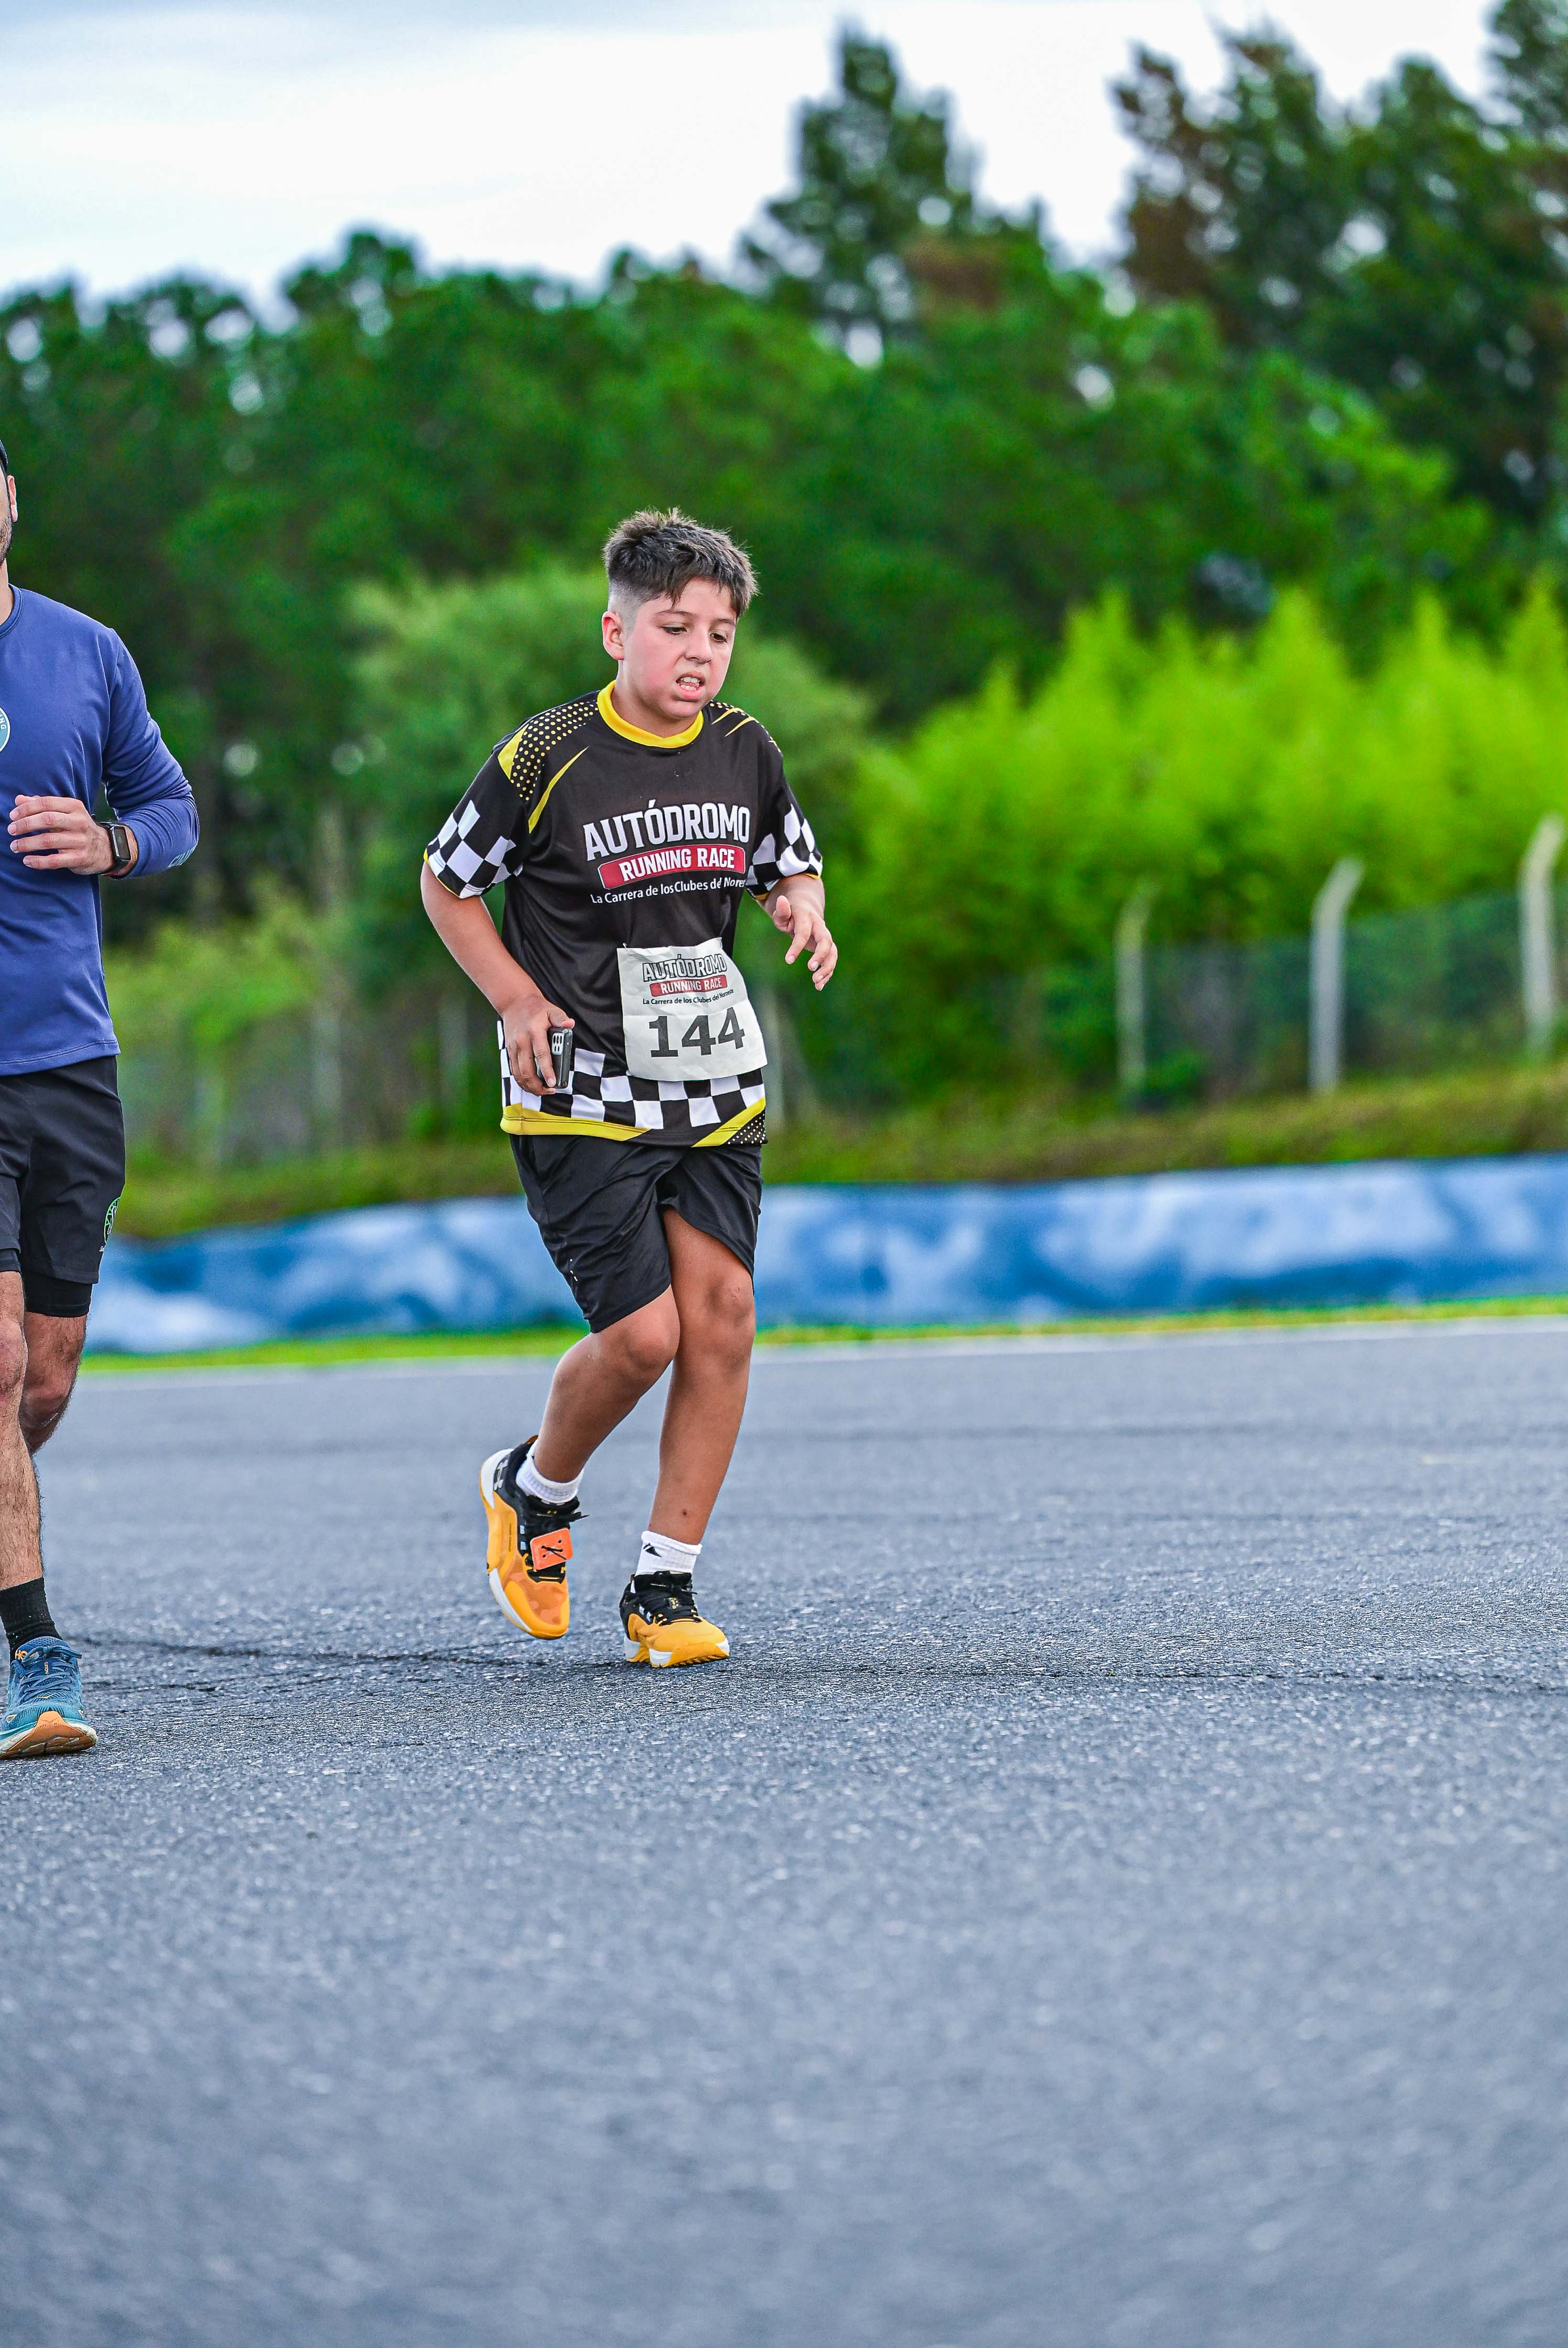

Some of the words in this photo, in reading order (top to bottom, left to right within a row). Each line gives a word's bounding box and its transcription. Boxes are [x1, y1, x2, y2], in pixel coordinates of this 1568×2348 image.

[582, 799, 751, 861] AUTÓDROMO
[619, 848, 692, 882] RUNNING
[696, 847, 735, 869] RACE
[590, 893, 603, 903] La
[604, 887, 644, 903] Carrera
[645, 885, 658, 897] de
[661, 883, 674, 895] los
[674, 880, 708, 892] Clubes
[642, 953, 727, 982] AUTÓDROMO
[660, 981, 702, 995] RUNNING
[704, 978, 722, 990] RACE
[648, 1007, 745, 1058] 144
